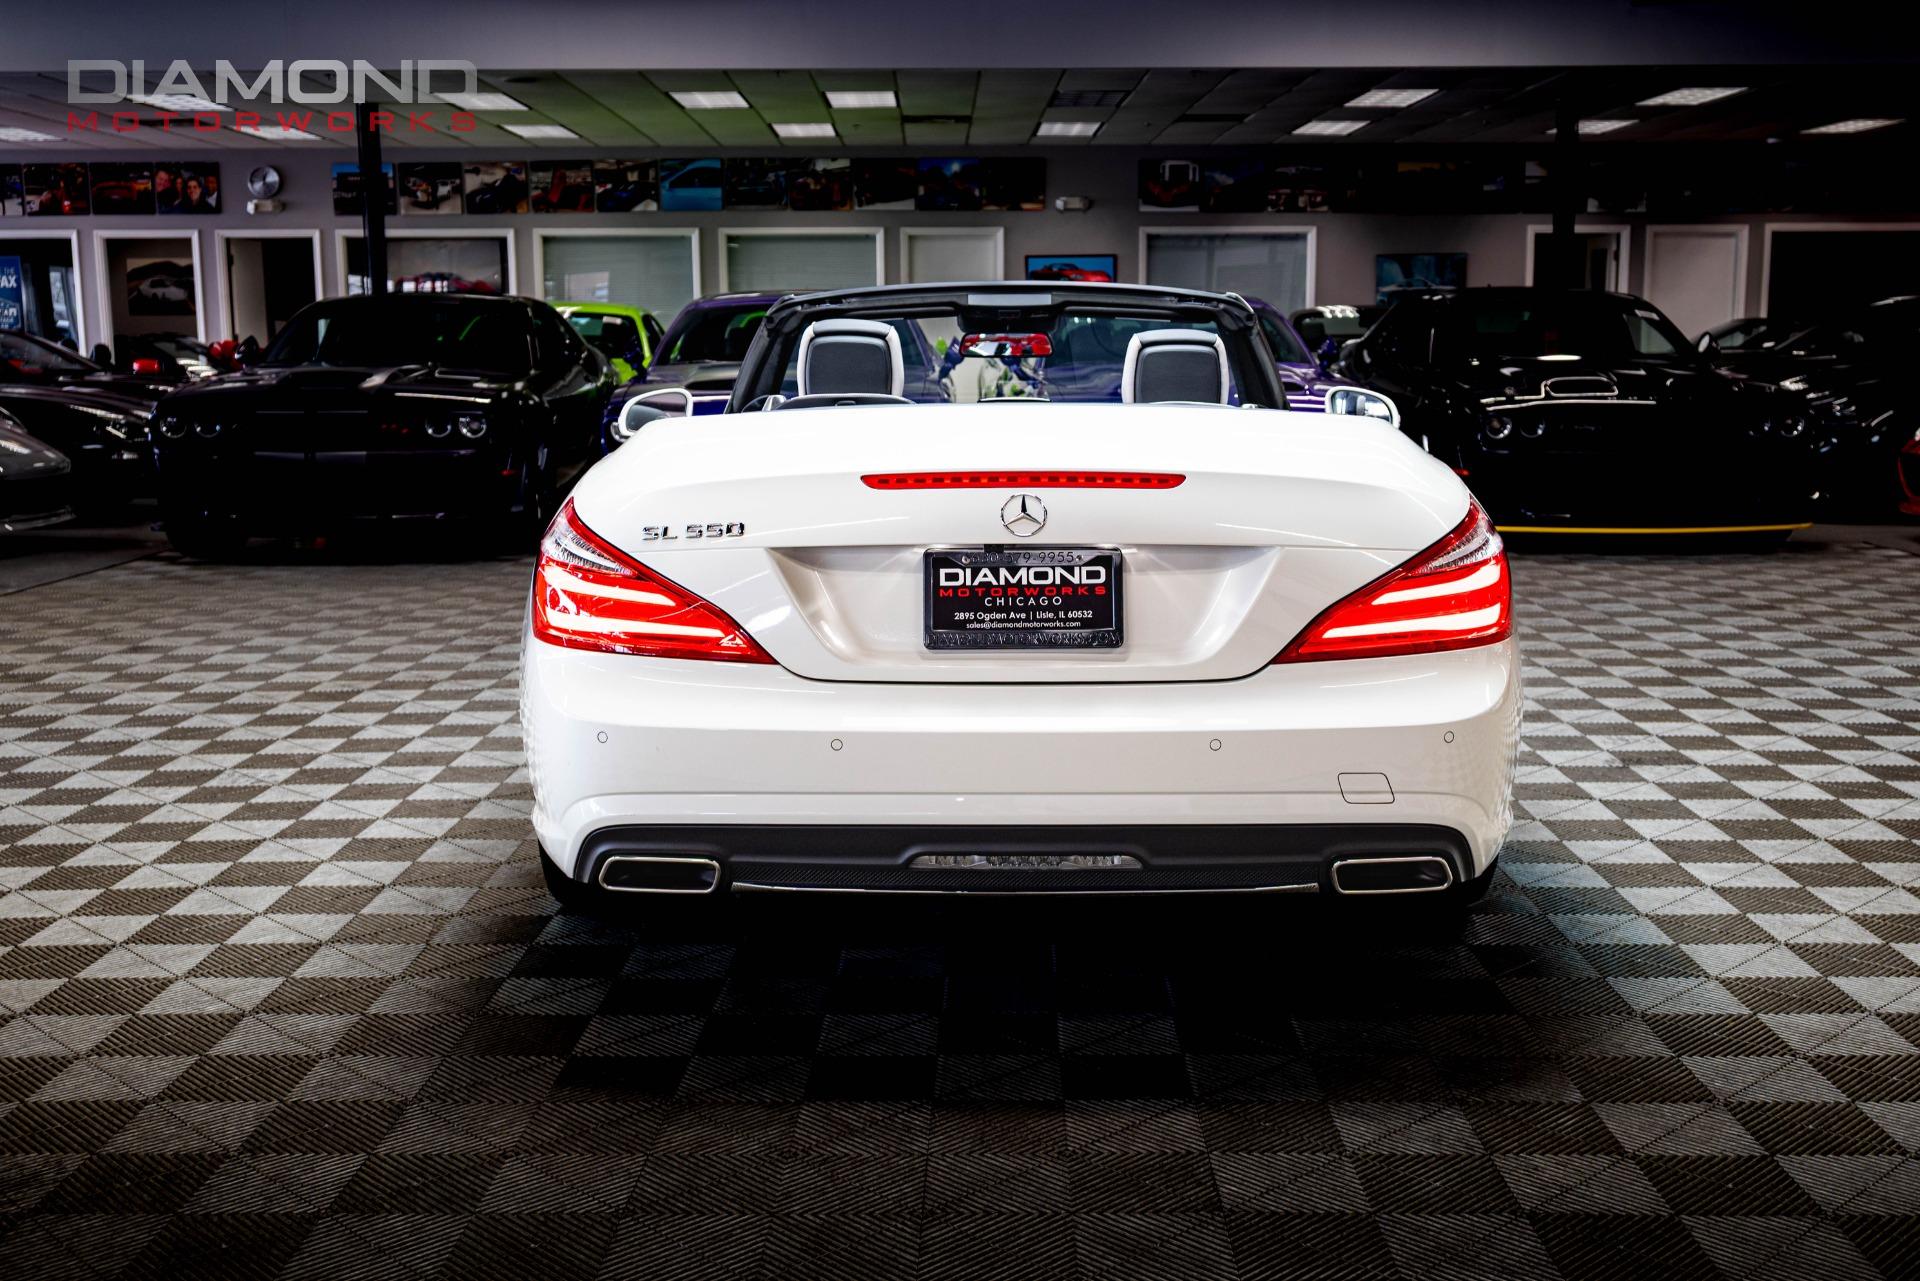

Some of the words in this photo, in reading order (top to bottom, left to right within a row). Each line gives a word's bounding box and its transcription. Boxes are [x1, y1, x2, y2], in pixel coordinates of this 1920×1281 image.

[0, 275, 17, 288] AX
[642, 526, 678, 540] SL
[685, 522, 745, 538] 550
[939, 566, 1106, 586] DIAMOND
[939, 586, 1106, 598] MOTORWORKS
[984, 596, 1062, 607] CHICAGO
[954, 612, 975, 620] 2895
[976, 611, 1007, 621] Ogden
[1009, 611, 1027, 619] Ave
[1036, 610, 1057, 620] Lisle,
[1058, 610, 1066, 619] IL
[1067, 610, 1093, 619] 60532
[966, 620, 1081, 629] sales@diamondmotorworks.com
